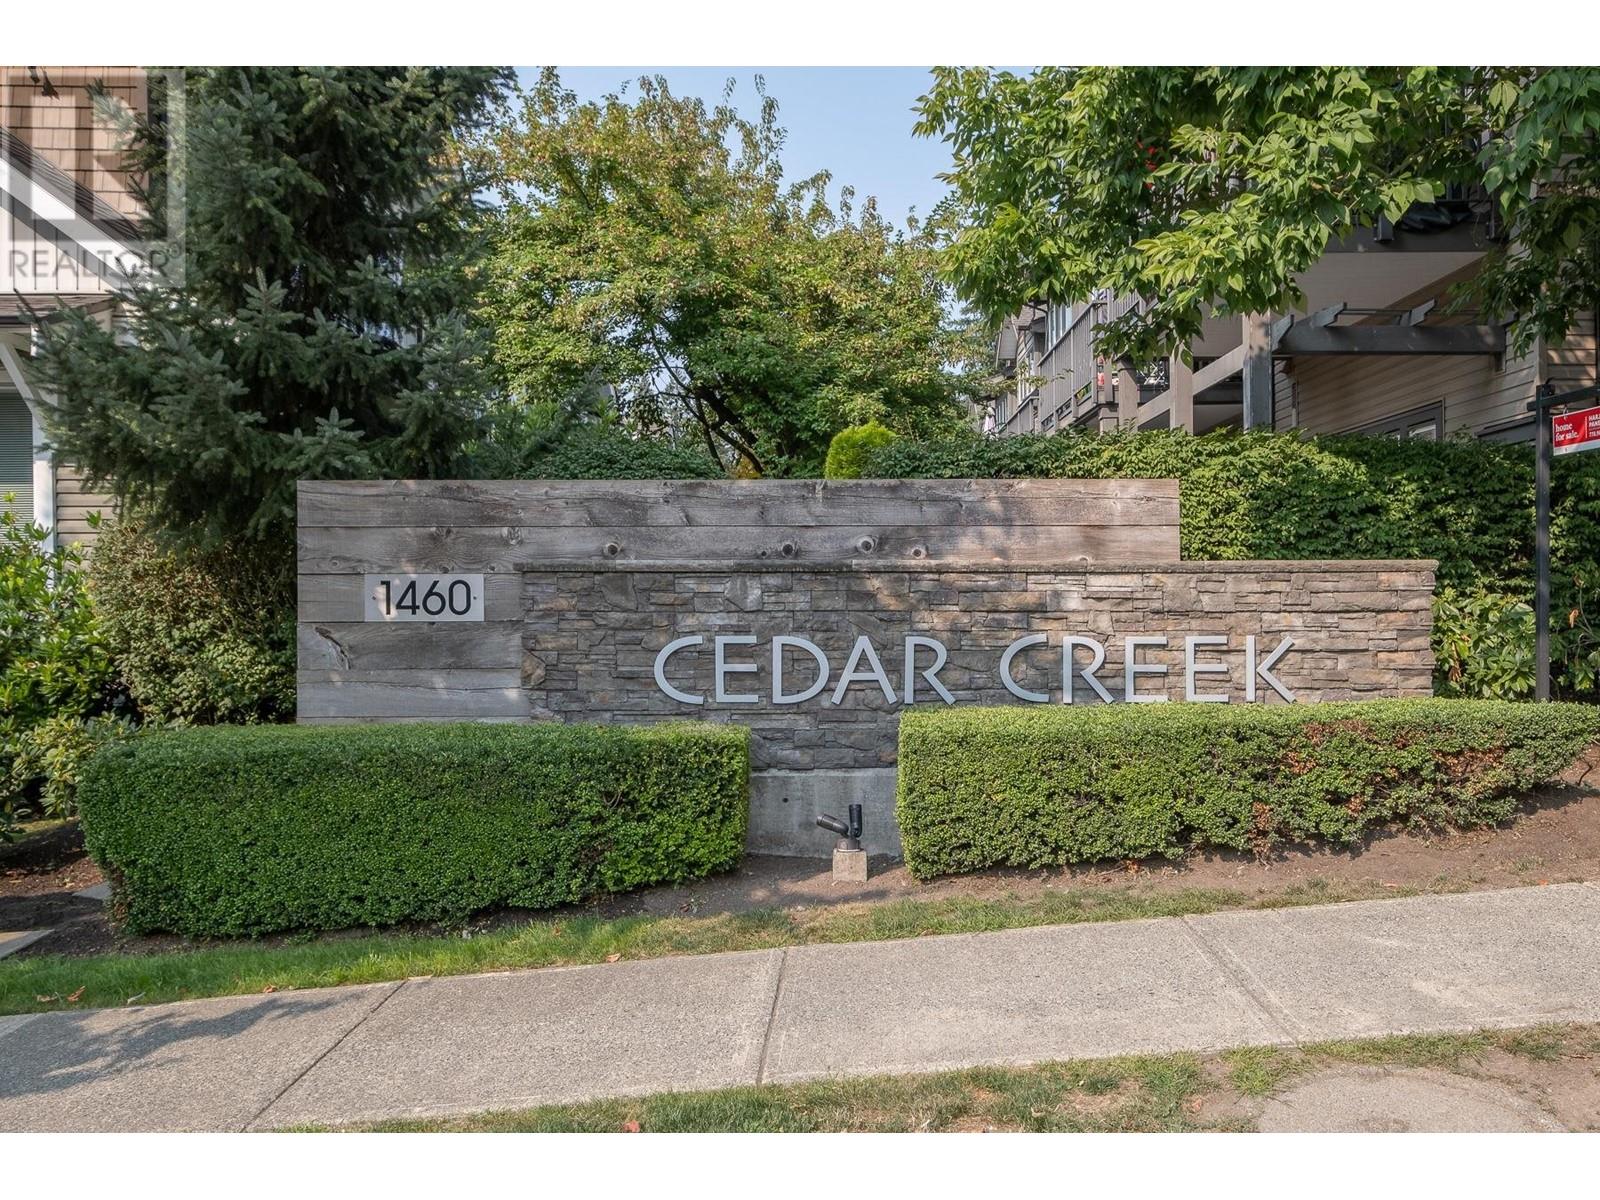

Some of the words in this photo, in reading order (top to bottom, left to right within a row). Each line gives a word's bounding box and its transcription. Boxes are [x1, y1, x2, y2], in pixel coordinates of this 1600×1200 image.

[1555, 423, 1573, 432] home
[1555, 432, 1565, 441] for
[380, 579, 471, 615] 1460
[653, 634, 956, 706] CEDAR
[999, 633, 1297, 704] CREEK
